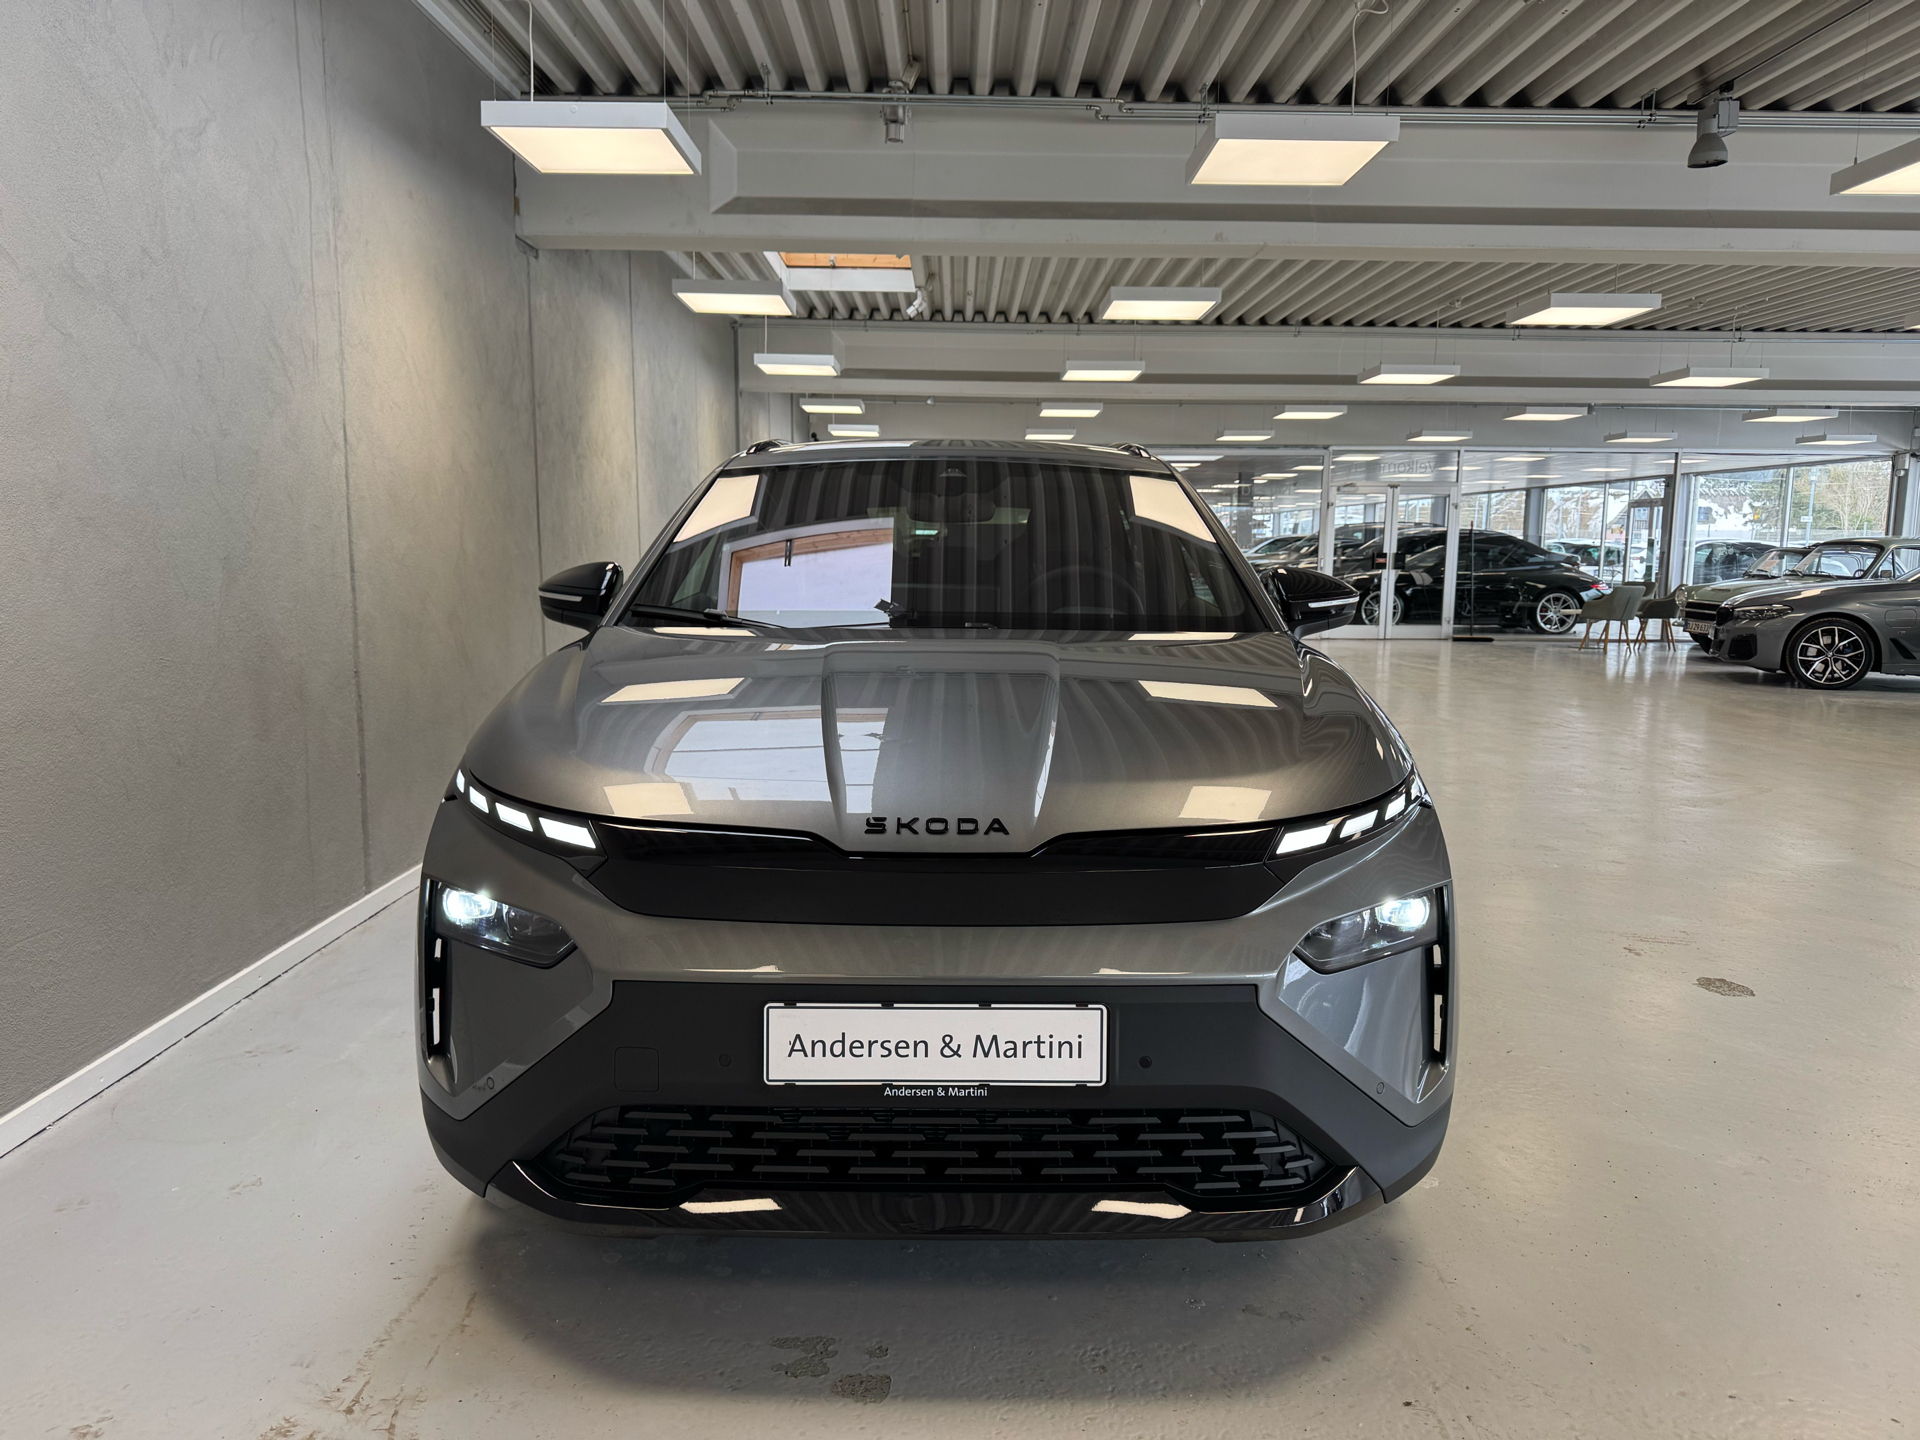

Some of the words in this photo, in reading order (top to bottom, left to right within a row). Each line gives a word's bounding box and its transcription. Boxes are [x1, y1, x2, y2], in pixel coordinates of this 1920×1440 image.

[787, 1031, 929, 1058] Andersen
[939, 1034, 962, 1059] &
[972, 1034, 1083, 1059] Martini
[883, 1086, 934, 1097] Andersen
[936, 1087, 946, 1097] &
[948, 1086, 988, 1097] Martini
